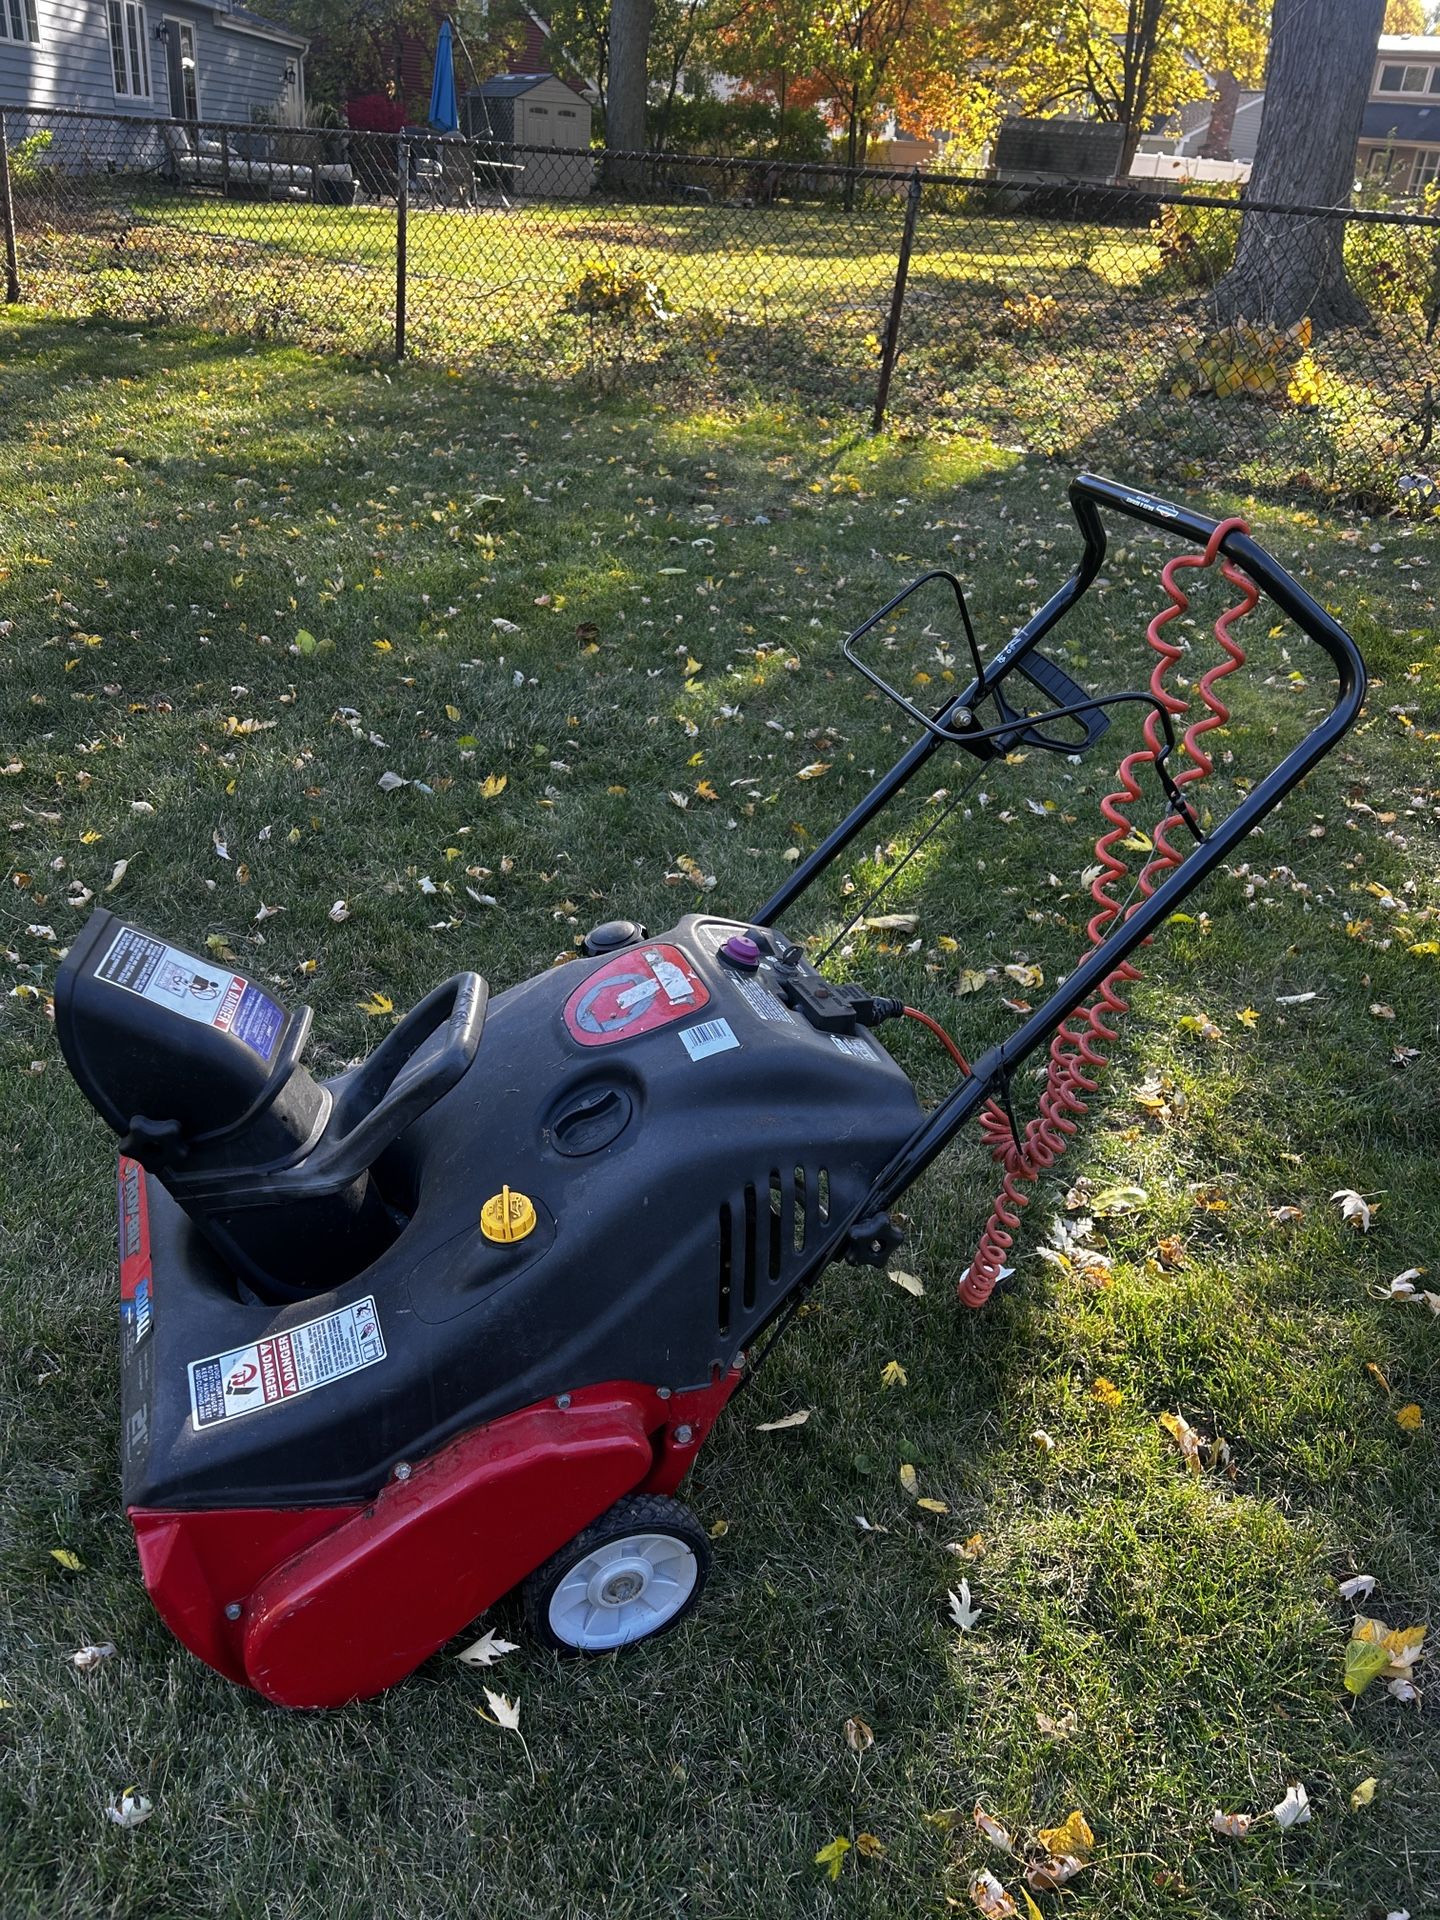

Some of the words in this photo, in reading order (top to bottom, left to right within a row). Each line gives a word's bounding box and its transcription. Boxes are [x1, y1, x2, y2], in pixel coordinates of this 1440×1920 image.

[216, 990, 239, 1024] DANGER
[260, 1354, 277, 1400] DANGER
[279, 1336, 294, 1381] DANGER
